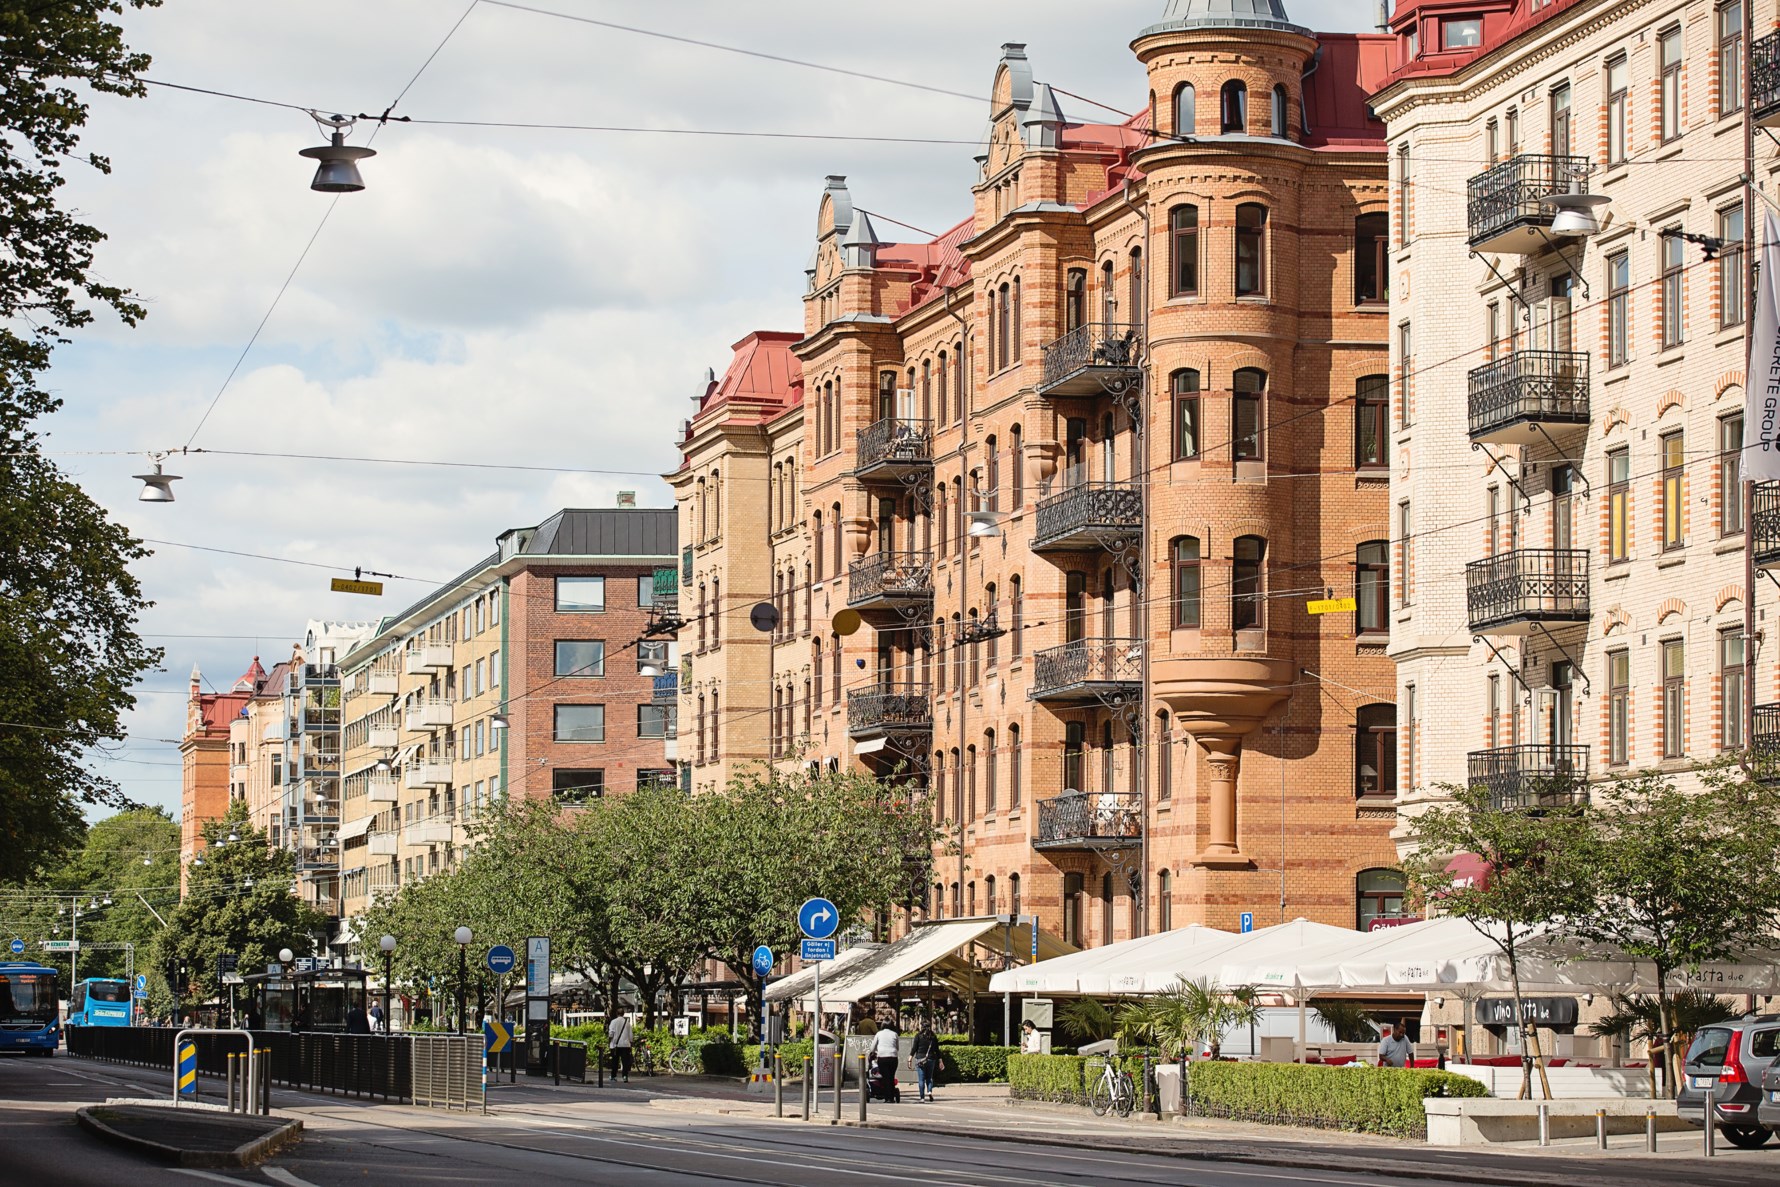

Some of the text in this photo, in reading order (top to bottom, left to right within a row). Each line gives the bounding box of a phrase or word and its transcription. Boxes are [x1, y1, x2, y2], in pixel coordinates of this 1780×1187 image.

[1760, 398, 1777, 451] GROUP
[1244, 915, 1250, 931] P
[534, 940, 543, 952] A
[1687, 968, 1723, 986] pasta
[1728, 971, 1744, 981] due
[1494, 1000, 1511, 1021] vino
